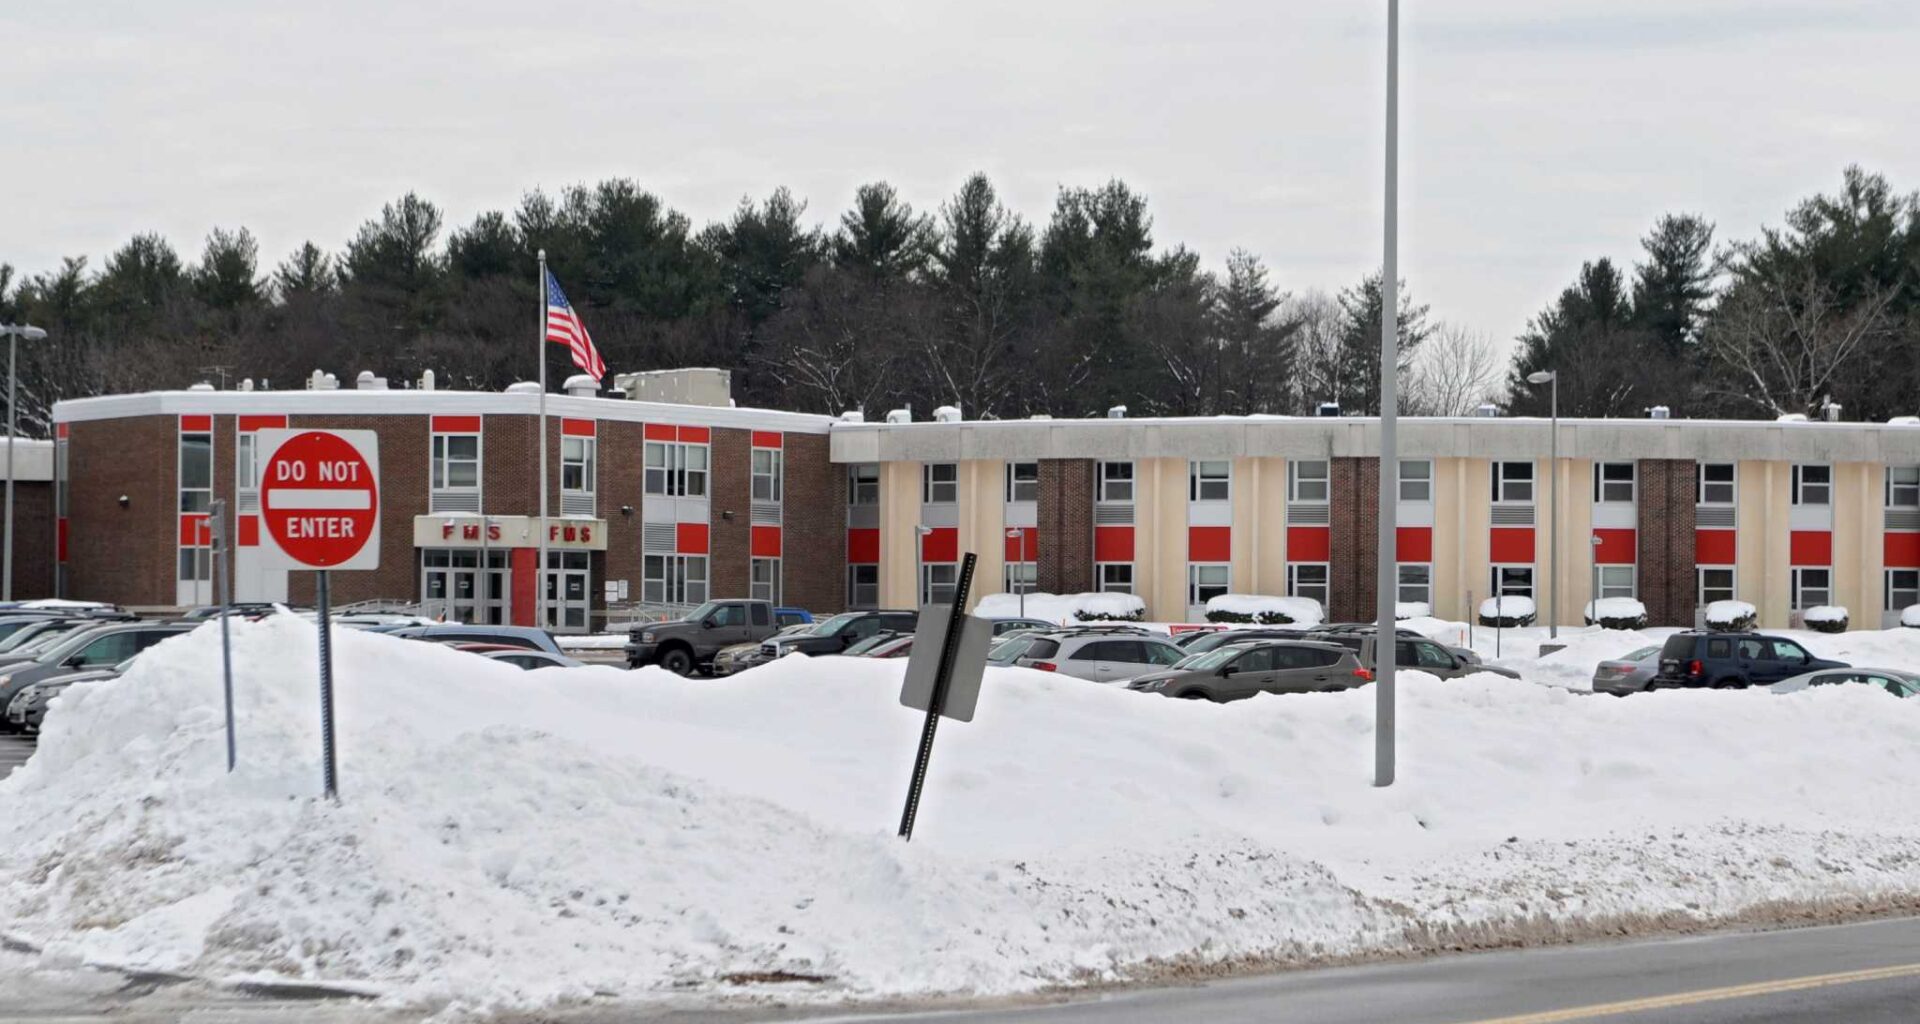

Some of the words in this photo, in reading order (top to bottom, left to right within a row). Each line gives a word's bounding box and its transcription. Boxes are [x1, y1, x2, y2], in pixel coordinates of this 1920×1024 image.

[277, 460, 306, 481] DO
[319, 461, 359, 482] NOT
[287, 517, 354, 538] ENTER
[550, 526, 591, 542] FMS
